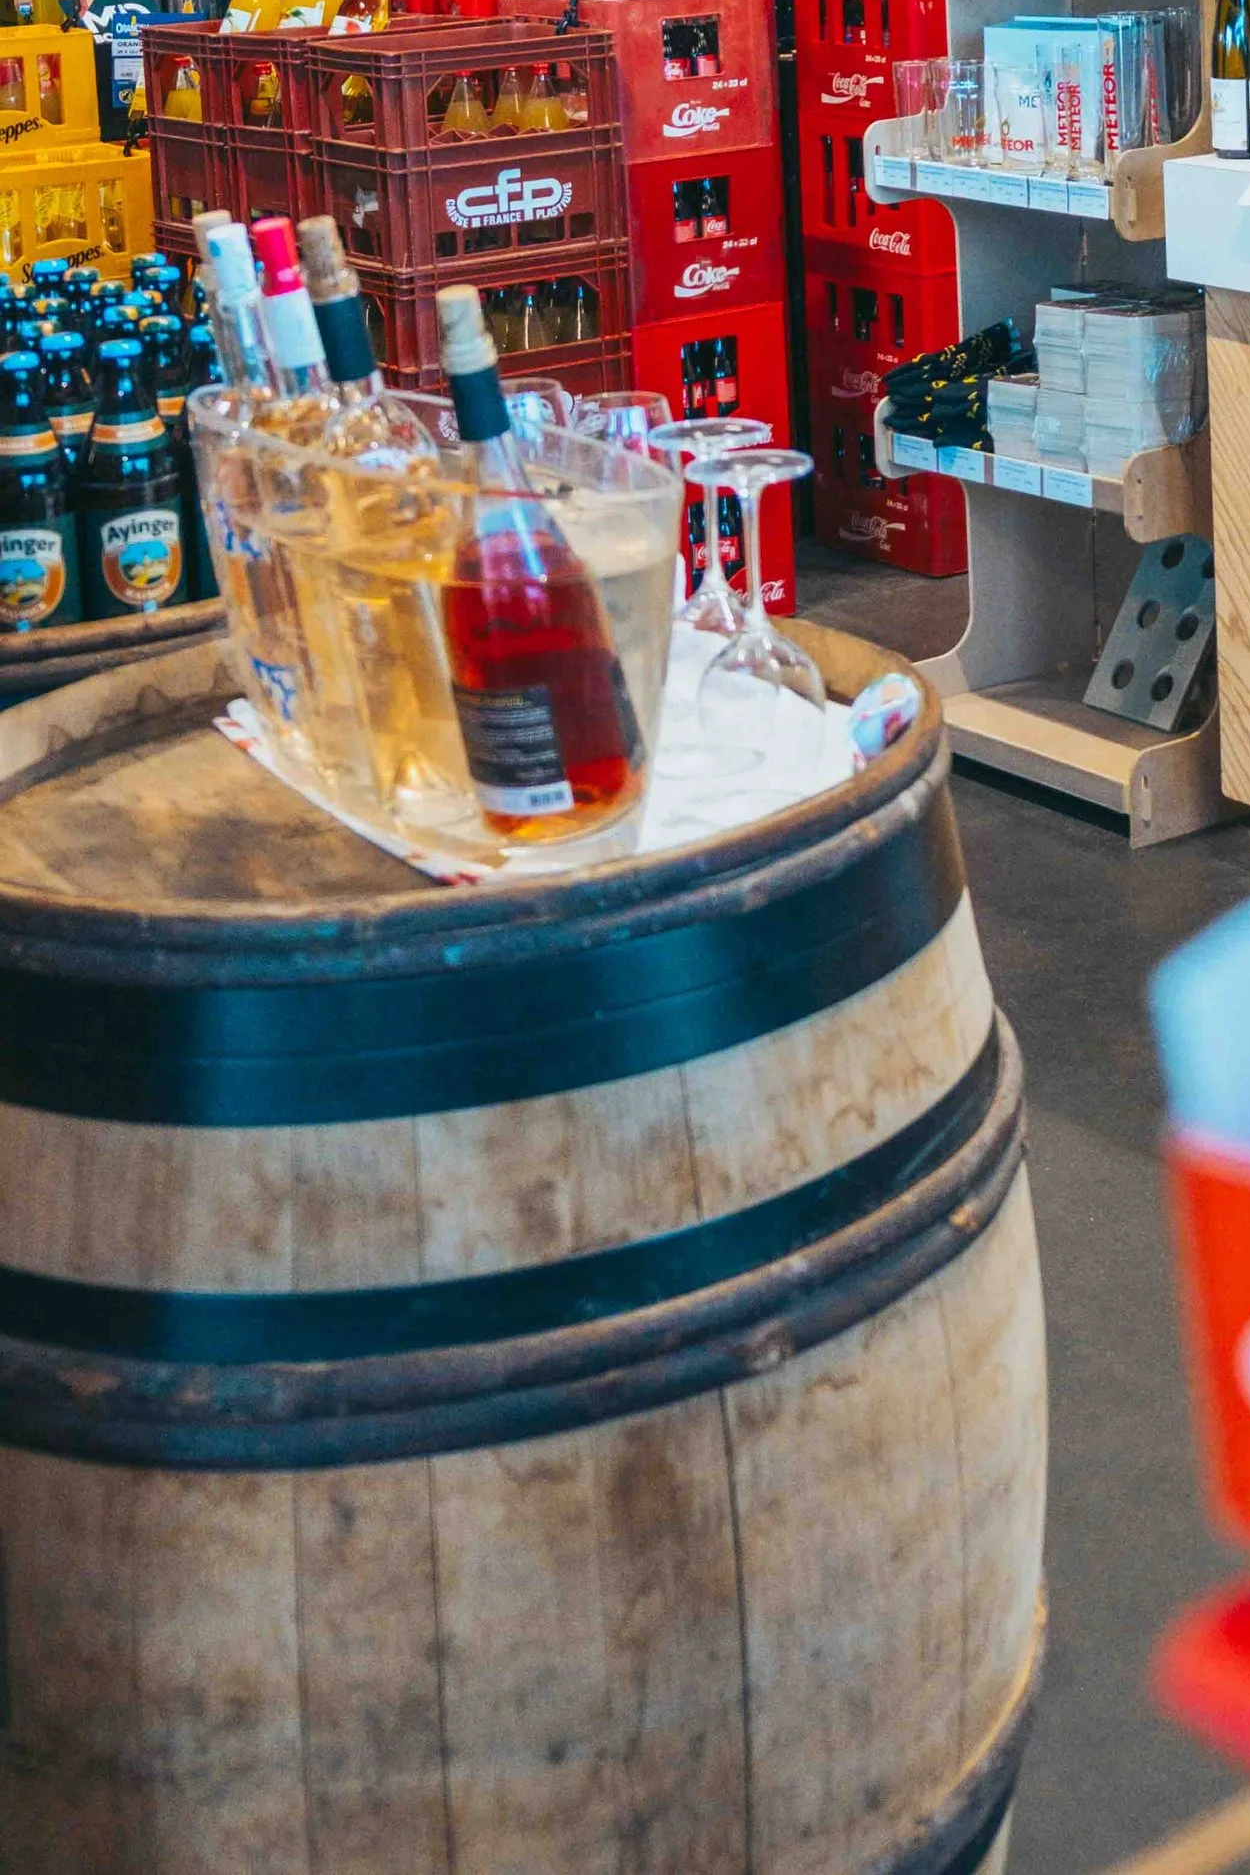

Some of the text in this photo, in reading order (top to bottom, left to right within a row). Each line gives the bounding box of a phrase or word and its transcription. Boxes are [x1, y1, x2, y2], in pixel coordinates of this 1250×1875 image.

[1102, 62, 1119, 151] METEOR
[445, 181, 573, 228] CAISSE FRANCE PLASTIQUE
[456, 168, 563, 222] cfp
[868, 227, 912, 257] Coca-Cola
[107, 518, 176, 543] Ayinger
